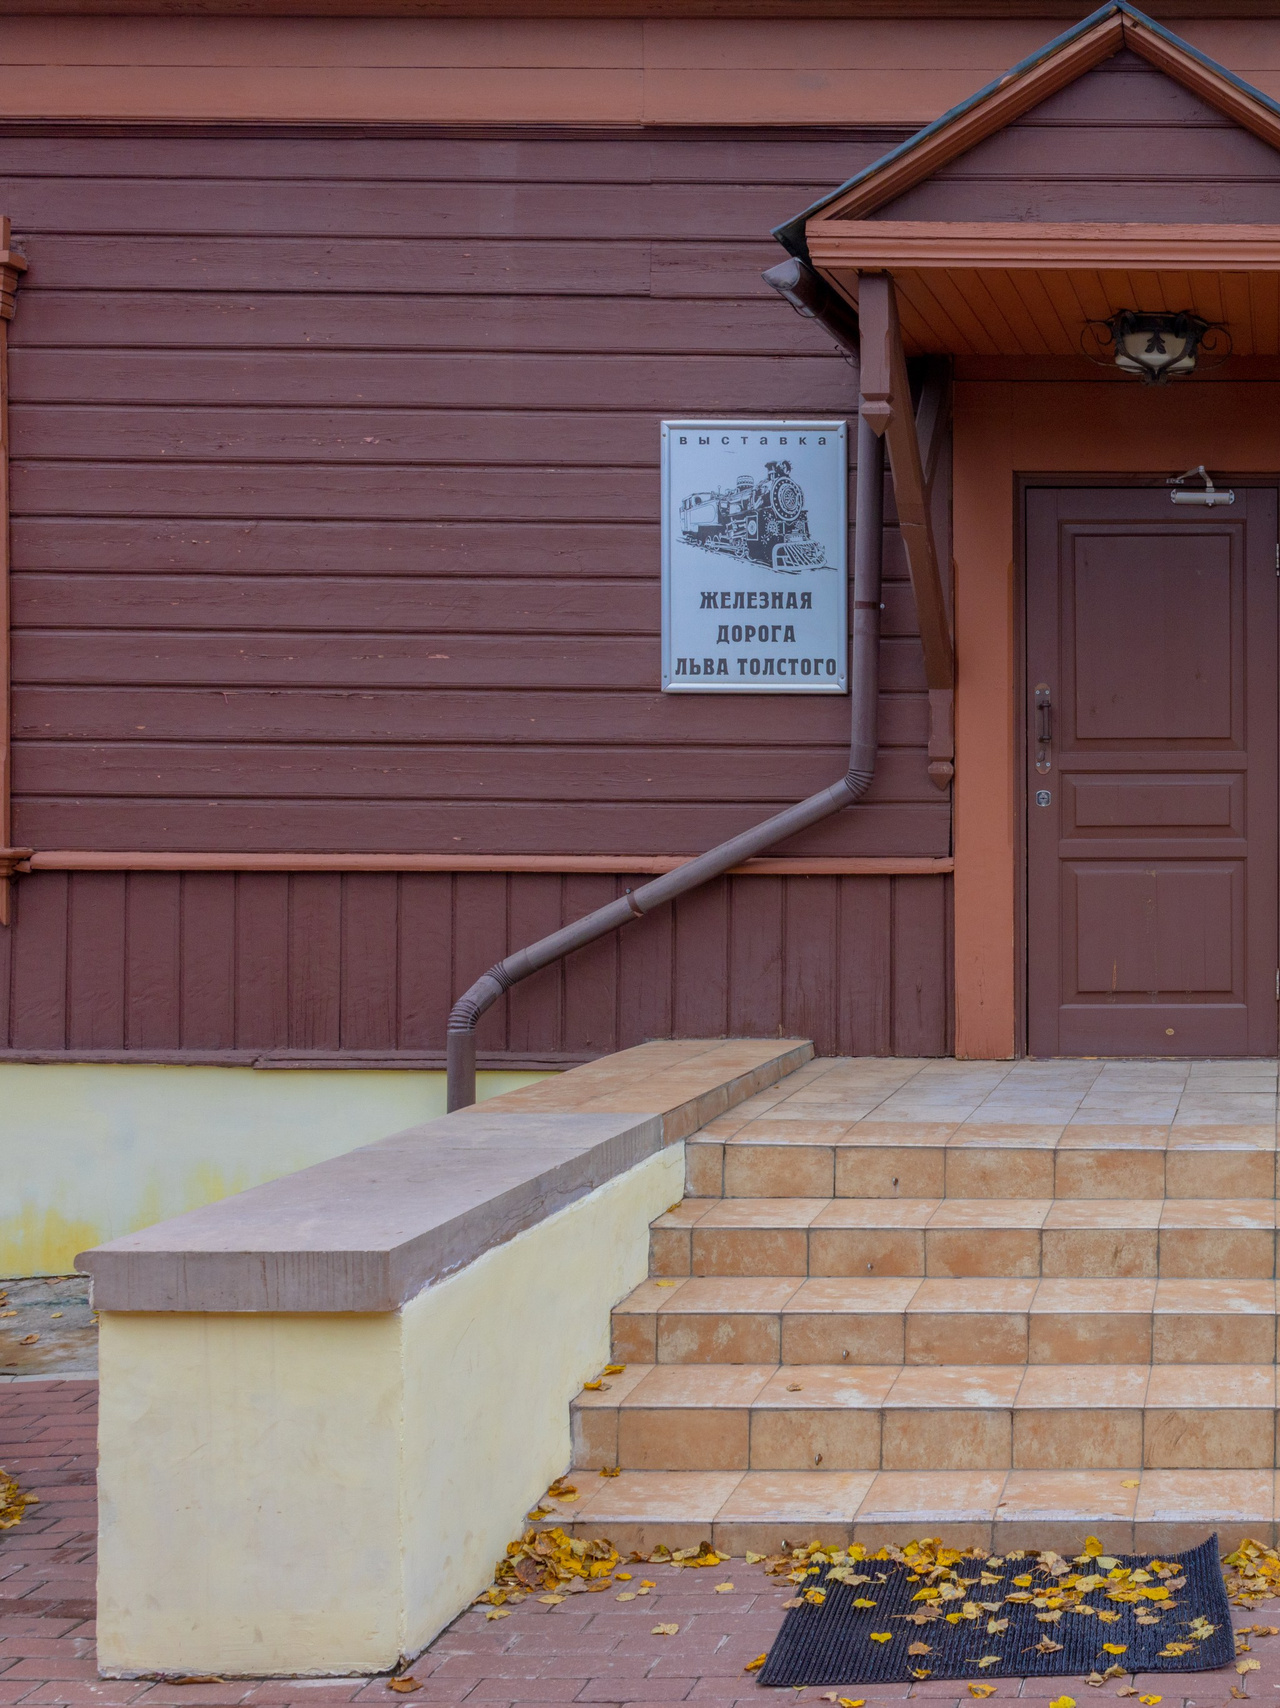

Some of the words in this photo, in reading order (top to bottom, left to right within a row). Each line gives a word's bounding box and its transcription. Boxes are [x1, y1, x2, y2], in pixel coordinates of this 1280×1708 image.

[679, 436, 827, 446] выставка
[699, 591, 813, 610] ЖЕЛЕЗНАЯ
[716, 624, 796, 645] ДОРОГА
[675, 657, 729, 676] ЛЬВА
[736, 657, 837, 676] ТОЛСТОГО
